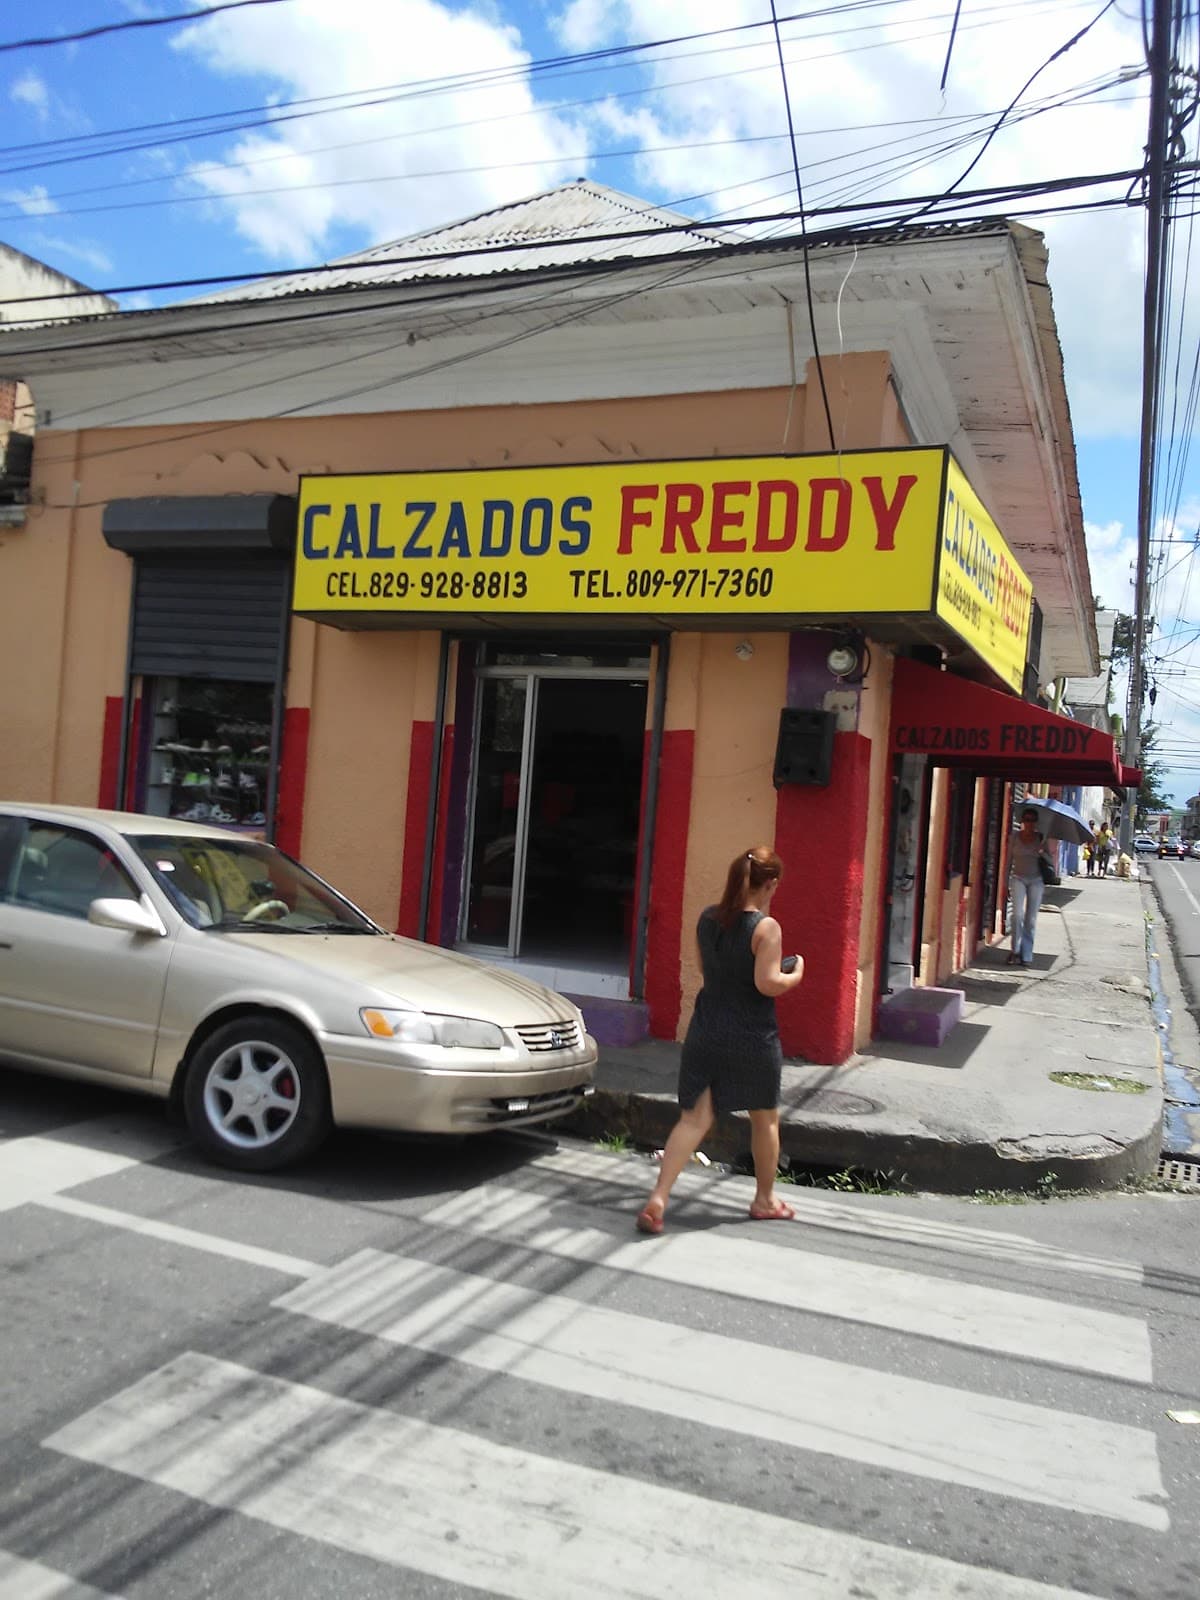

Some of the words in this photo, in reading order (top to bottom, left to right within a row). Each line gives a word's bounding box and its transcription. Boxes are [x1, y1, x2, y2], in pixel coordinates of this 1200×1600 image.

[303, 497, 592, 559] CALZADOS
[617, 475, 918, 554] FREDDY
[945, 489, 997, 604] CALZADOS
[997, 551, 1031, 641] FREDDY
[896, 727, 990, 750] CALZADOS
[1000, 724, 1093, 753] FREDDY
